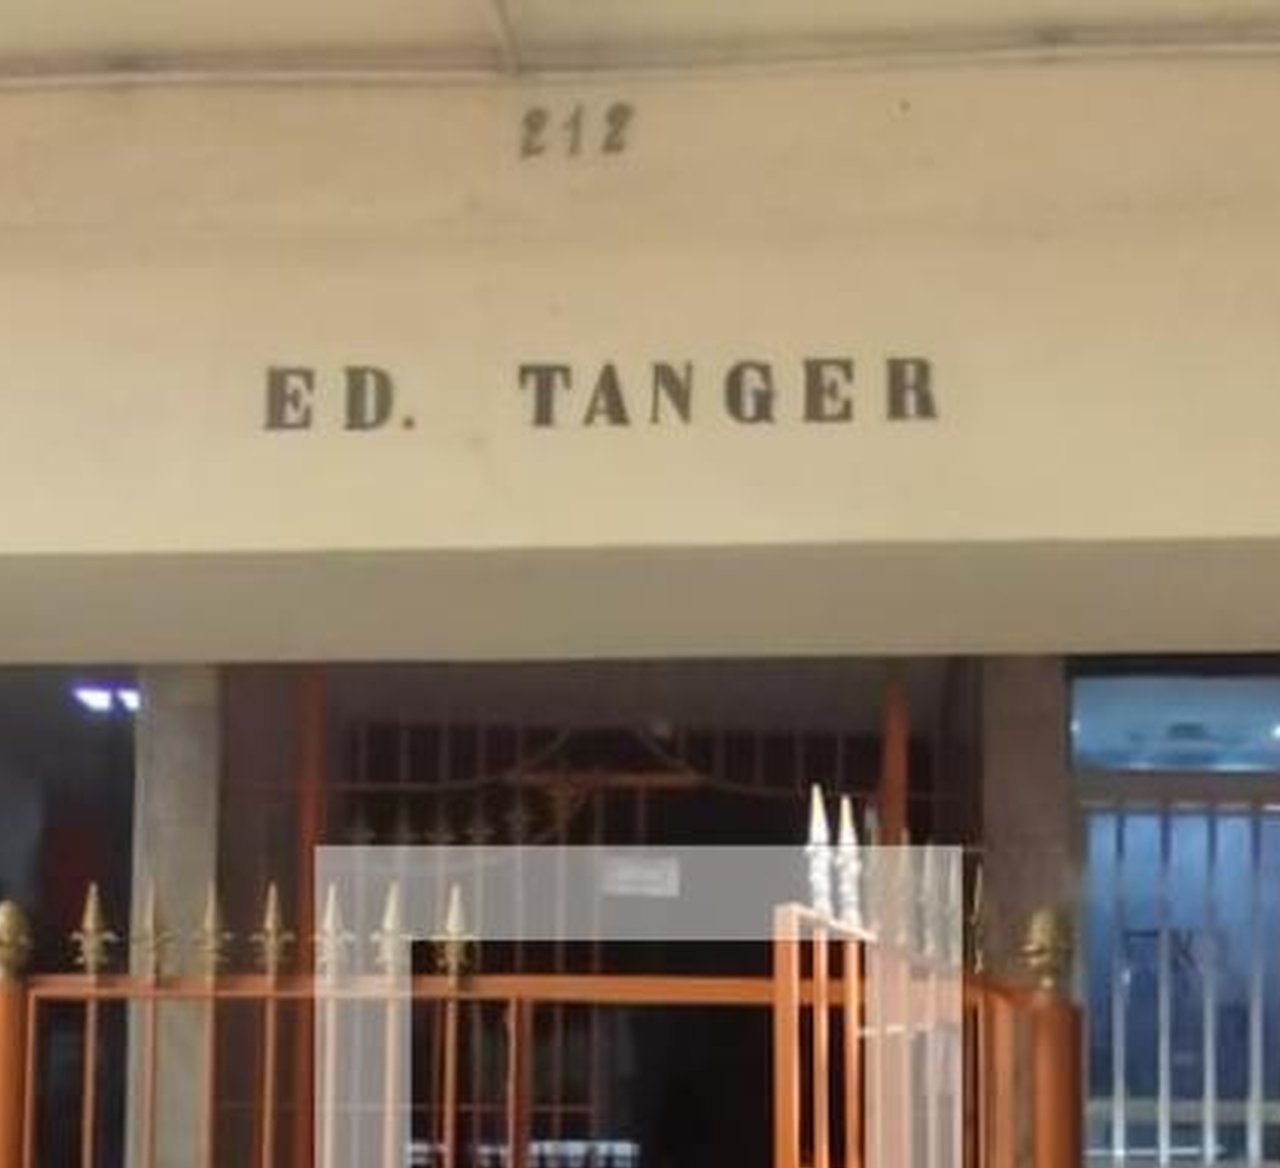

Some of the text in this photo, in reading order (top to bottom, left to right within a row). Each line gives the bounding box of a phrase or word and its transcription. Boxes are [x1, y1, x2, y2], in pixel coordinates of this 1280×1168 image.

[521, 102, 635, 159] 212
[264, 358, 938, 430] ED. TANGER
